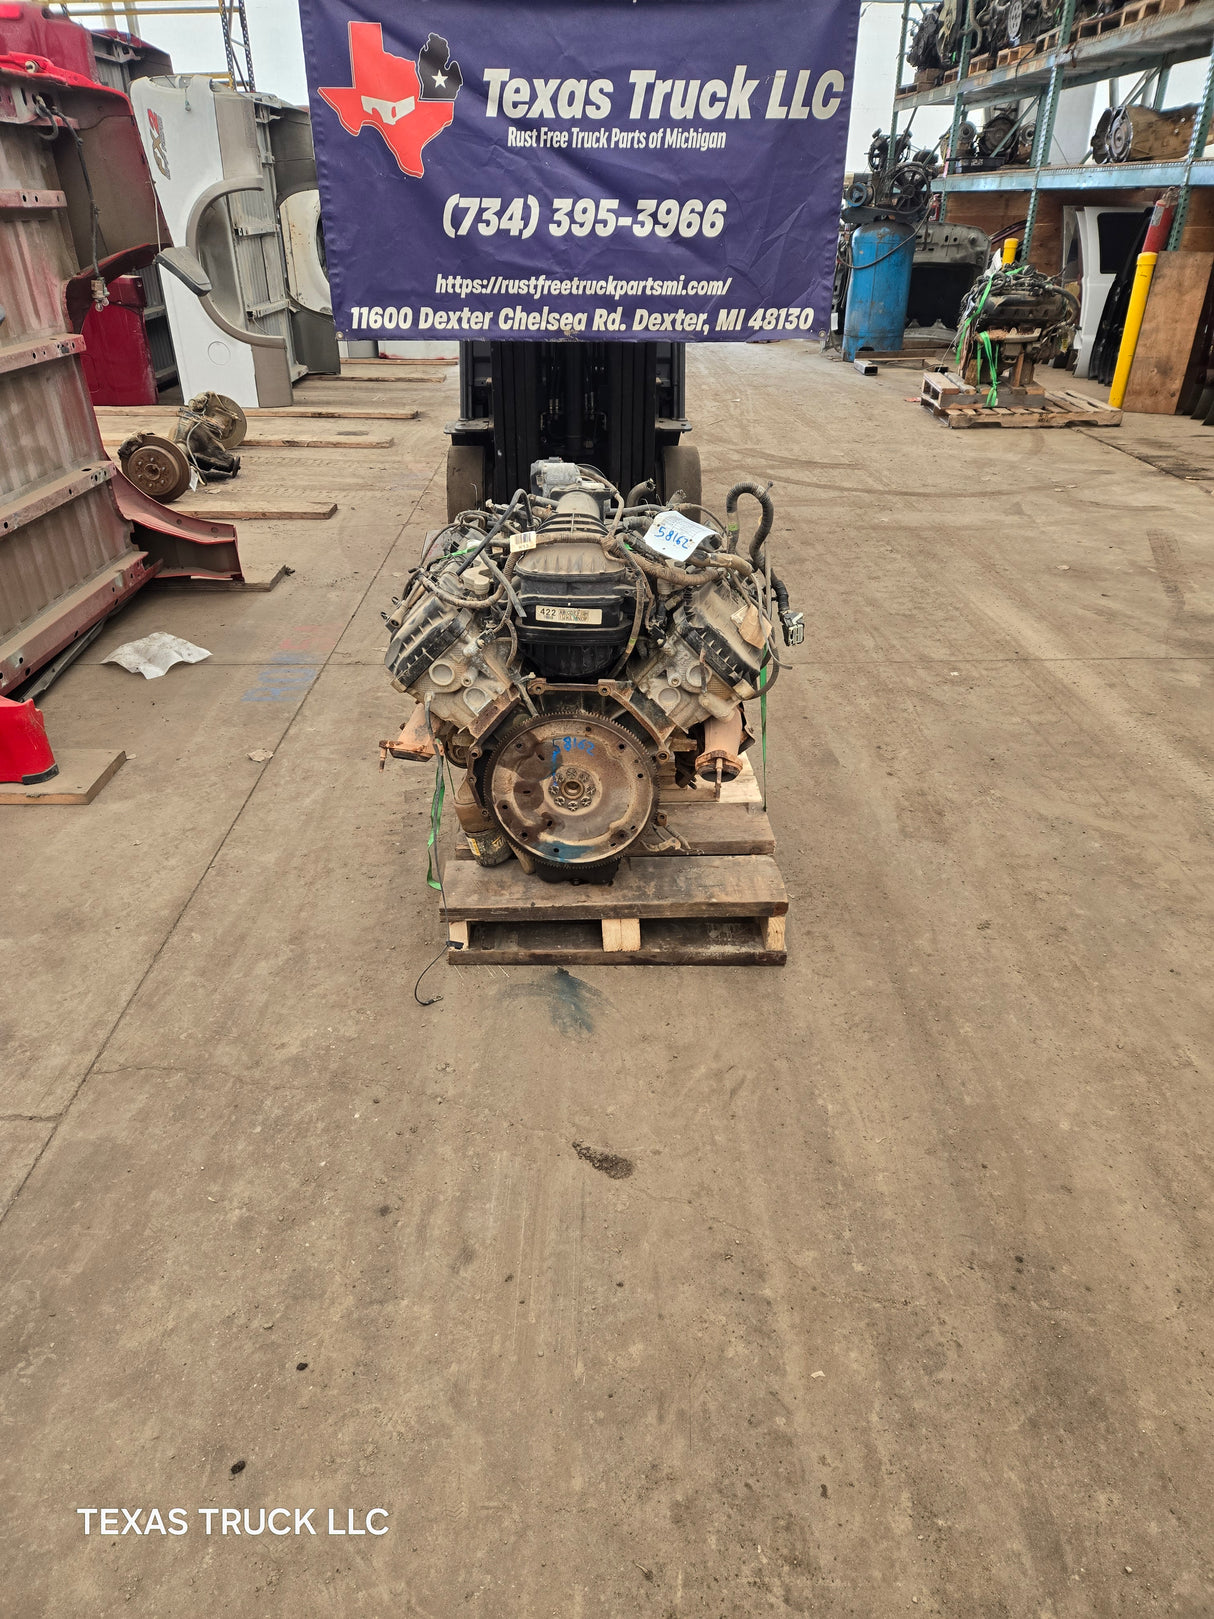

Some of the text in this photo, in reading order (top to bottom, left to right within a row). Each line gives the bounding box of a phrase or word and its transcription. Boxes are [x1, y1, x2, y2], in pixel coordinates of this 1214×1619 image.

[483, 65, 845, 120] Texas Truck LLC
[507, 127, 727, 151] Rust Free Truck Parts of Michigan
[442, 193, 727, 239] (734) 395-3966
[435, 273, 733, 297] https://rustfreetruckpartsmi.com/
[350, 305, 815, 335] 11600 Dexter Chelsea Rd. Dexter, MI 48130
[654, 526, 689, 549] 58162
[540, 608, 556, 616] 422
